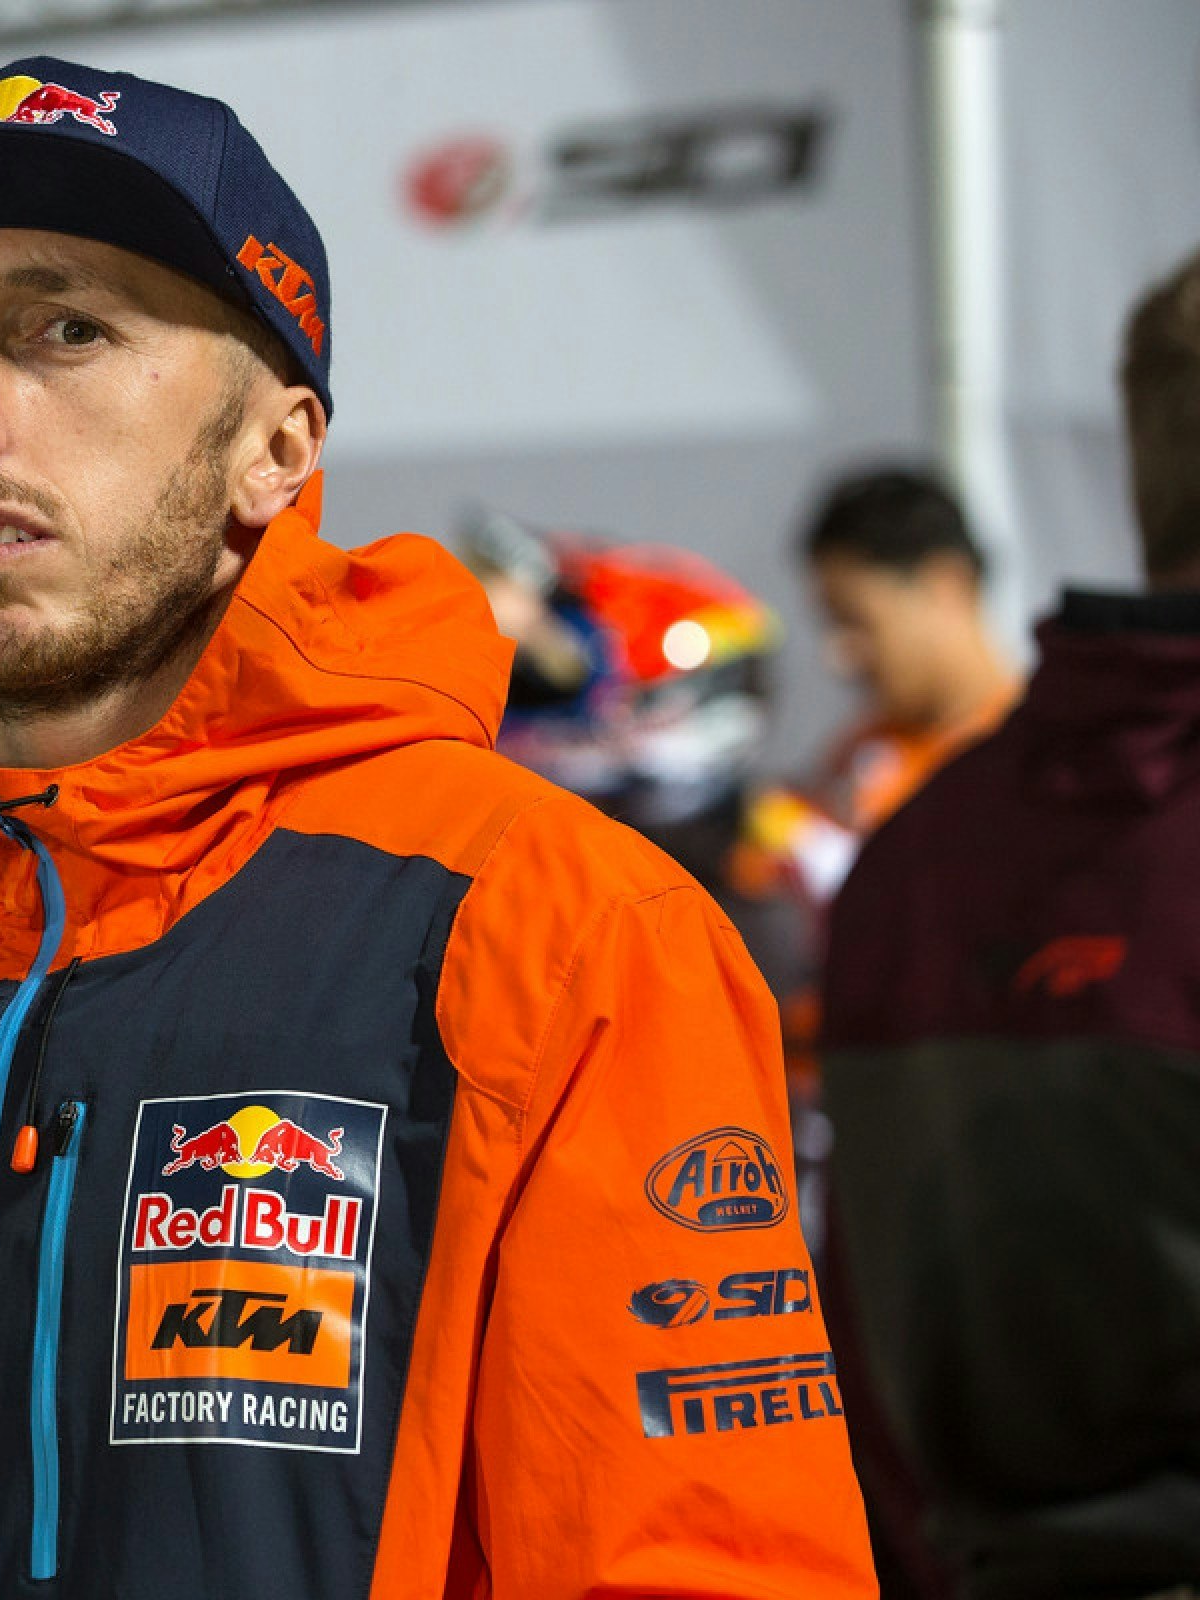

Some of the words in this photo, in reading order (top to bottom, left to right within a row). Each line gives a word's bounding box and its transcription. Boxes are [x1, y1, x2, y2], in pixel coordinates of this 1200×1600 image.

[236, 234, 325, 357] KTM
[667, 1144, 779, 1207] Airoh
[132, 1183, 240, 1252] Red
[240, 1187, 362, 1260] Bull
[150, 1289, 323, 1355] KTM
[713, 1268, 813, 1321] SID
[123, 1391, 233, 1424] FACTORY
[243, 1393, 348, 1433] RACING
[636, 1352, 843, 1438] PIRELL
